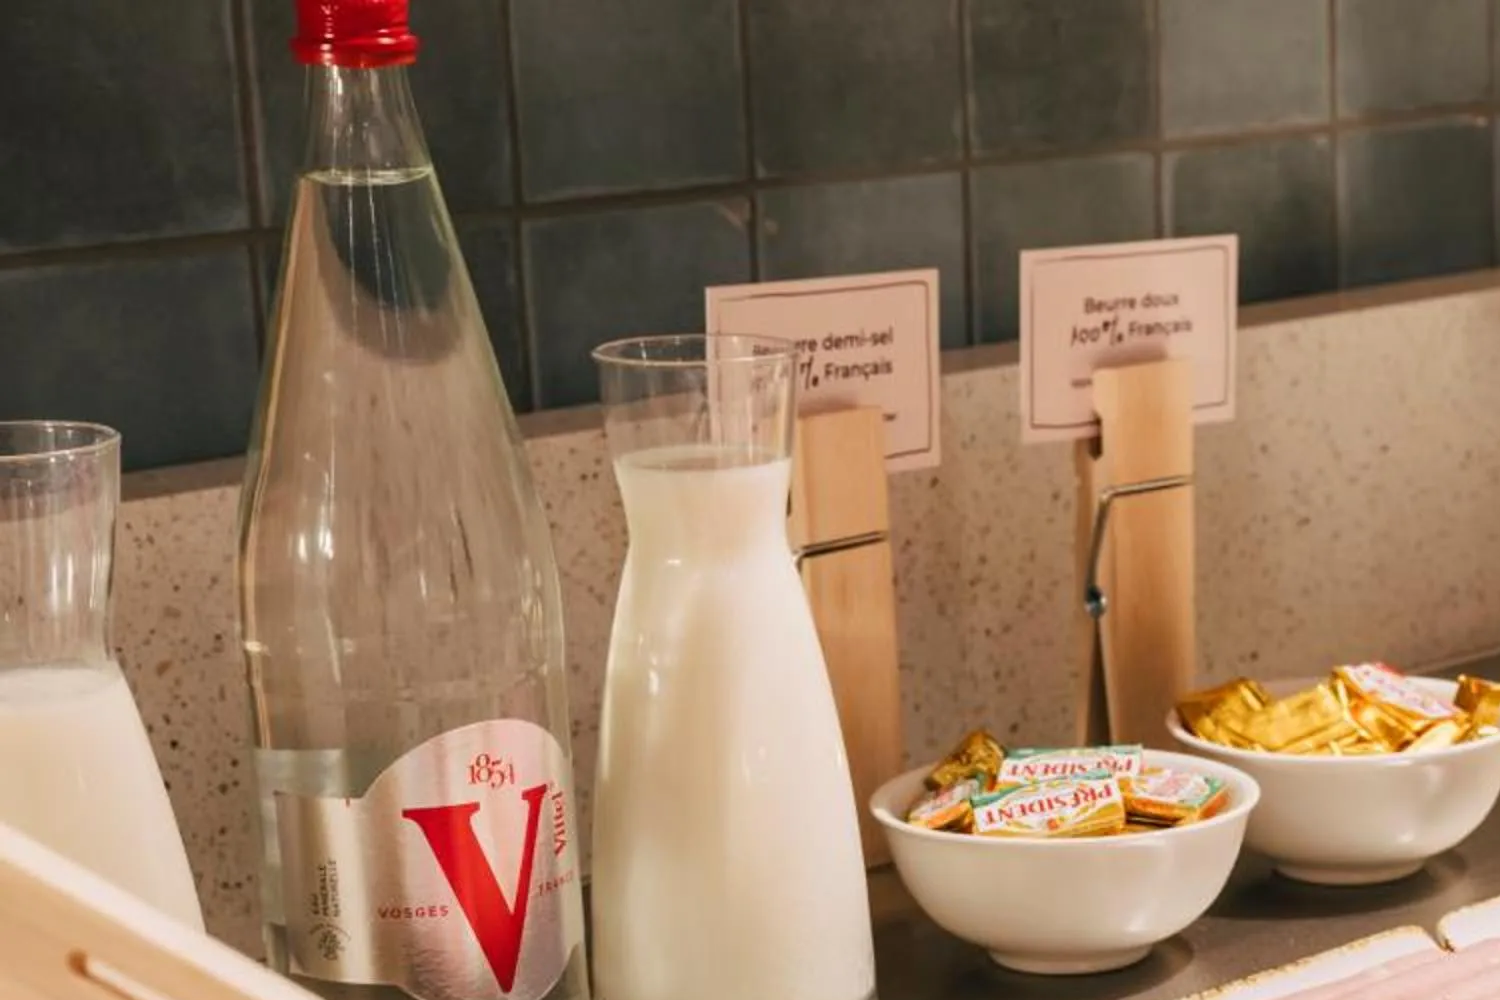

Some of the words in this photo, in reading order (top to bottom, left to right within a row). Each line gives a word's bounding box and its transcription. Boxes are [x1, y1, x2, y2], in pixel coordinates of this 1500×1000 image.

[1084, 297, 1137, 314] Beurre
[1140, 293, 1179, 308] doux
[821, 326, 893, 350] demi-sel
[1070, 315, 1124, 347] 100%
[1128, 318, 1192, 338] Français
[824, 357, 893, 381] Français
[551, 790, 568, 858] Vittel
[401, 783, 548, 993] V
[377, 904, 450, 920] VOSGES
